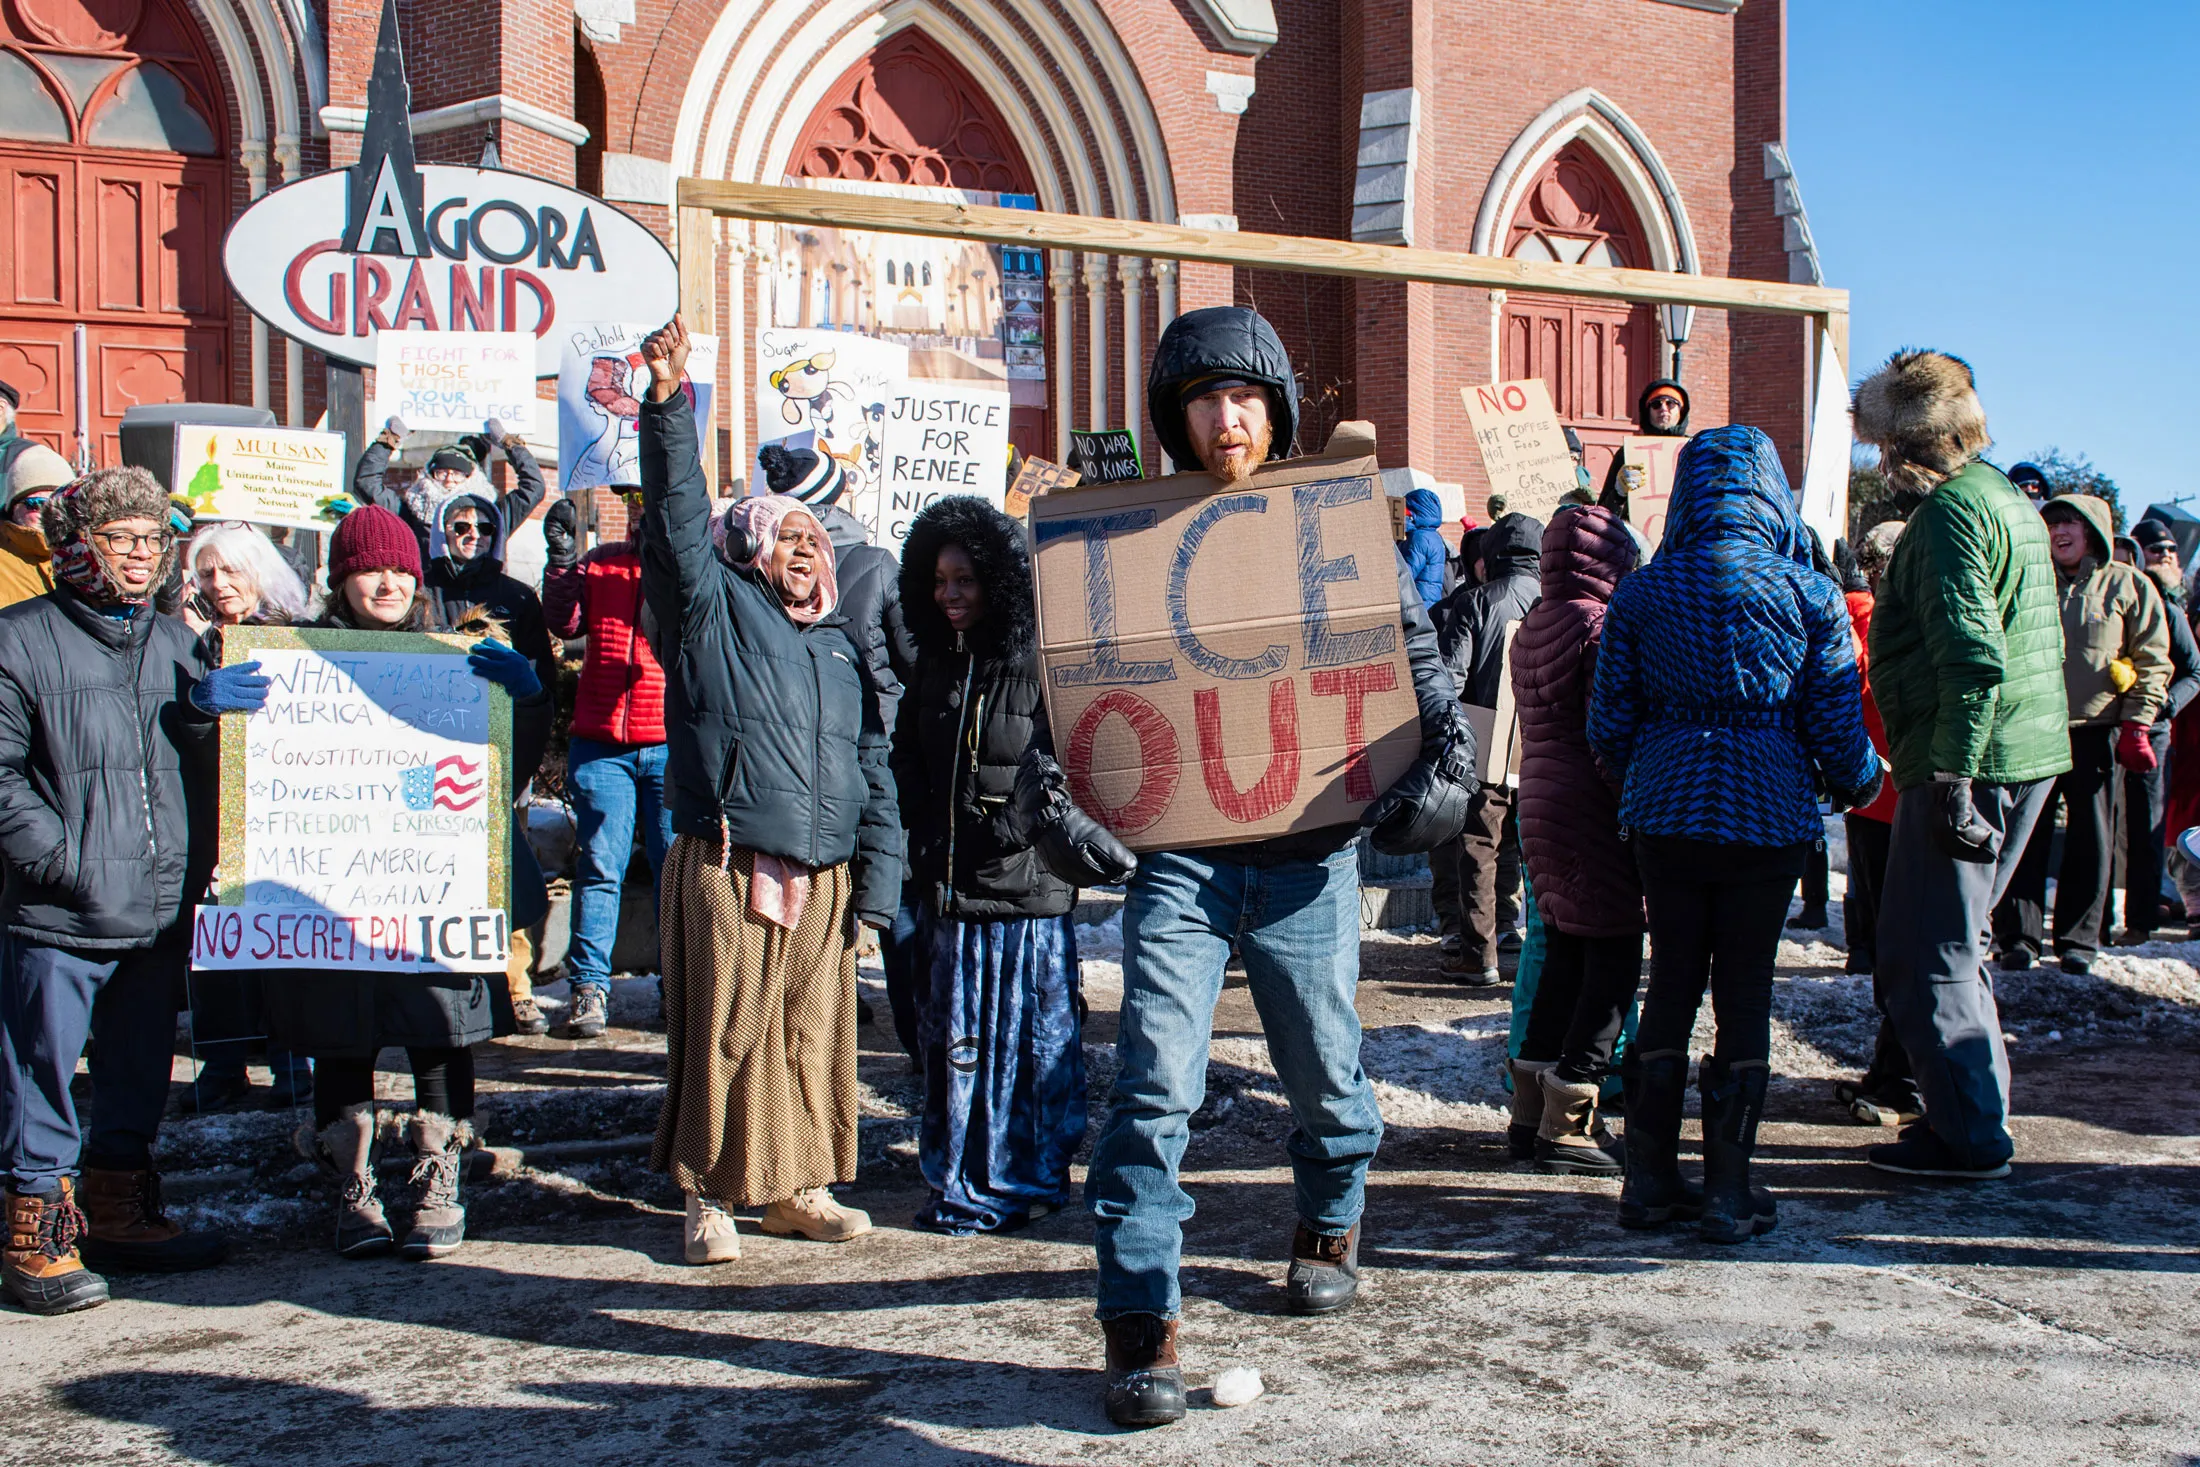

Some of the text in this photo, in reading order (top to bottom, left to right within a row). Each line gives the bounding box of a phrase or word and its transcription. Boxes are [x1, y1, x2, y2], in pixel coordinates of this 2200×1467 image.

[356, 153, 606, 272] AGORA
[284, 239, 555, 339] GRAND
[571, 325, 626, 357] Behold
[400, 346, 519, 361] FIGHT FOR
[398, 363, 470, 378] THOSE
[400, 378, 503, 393] WITHOUT
[408, 390, 467, 403] YOUR
[400, 401, 526, 421] PRIVILEGE
[891, 397, 1000, 426] JUSTICE
[1476, 385, 1527, 416] NO
[922, 428, 970, 455] FOR
[1477, 421, 1550, 444] HOT COFFEE
[236, 438, 328, 460] MUUSAN
[1075, 434, 1134, 457] NO WAR
[1484, 440, 1541, 464] HOT FOOD
[265, 460, 297, 471] Maine
[892, 455, 980, 485] RENEE
[1022, 457, 1074, 488] ICE
[1082, 458, 1140, 480] NO KINGS
[226, 469, 333, 488] Unitarian Universalist
[1015, 478, 1049, 497] OU
[1504, 480, 1575, 500] GROCERIES
[1518, 473, 1544, 489] GAS
[243, 484, 315, 499] State Advocacy
[257, 496, 299, 509] Network
[1035, 477, 1396, 688] ICE
[256, 658, 482, 704] WHAT MAKES
[249, 701, 373, 726] AMERICA
[271, 739, 428, 766] CONSTITUTION
[1064, 661, 1399, 836] OUT
[268, 811, 371, 834] FREEDOM
[392, 812, 488, 834] EXPRESSION
[254, 846, 456, 878] MAKE AMERICA
[255, 881, 451, 908] GREAT AGAIN!
[196, 911, 506, 963] NO SECRET POLICE!
